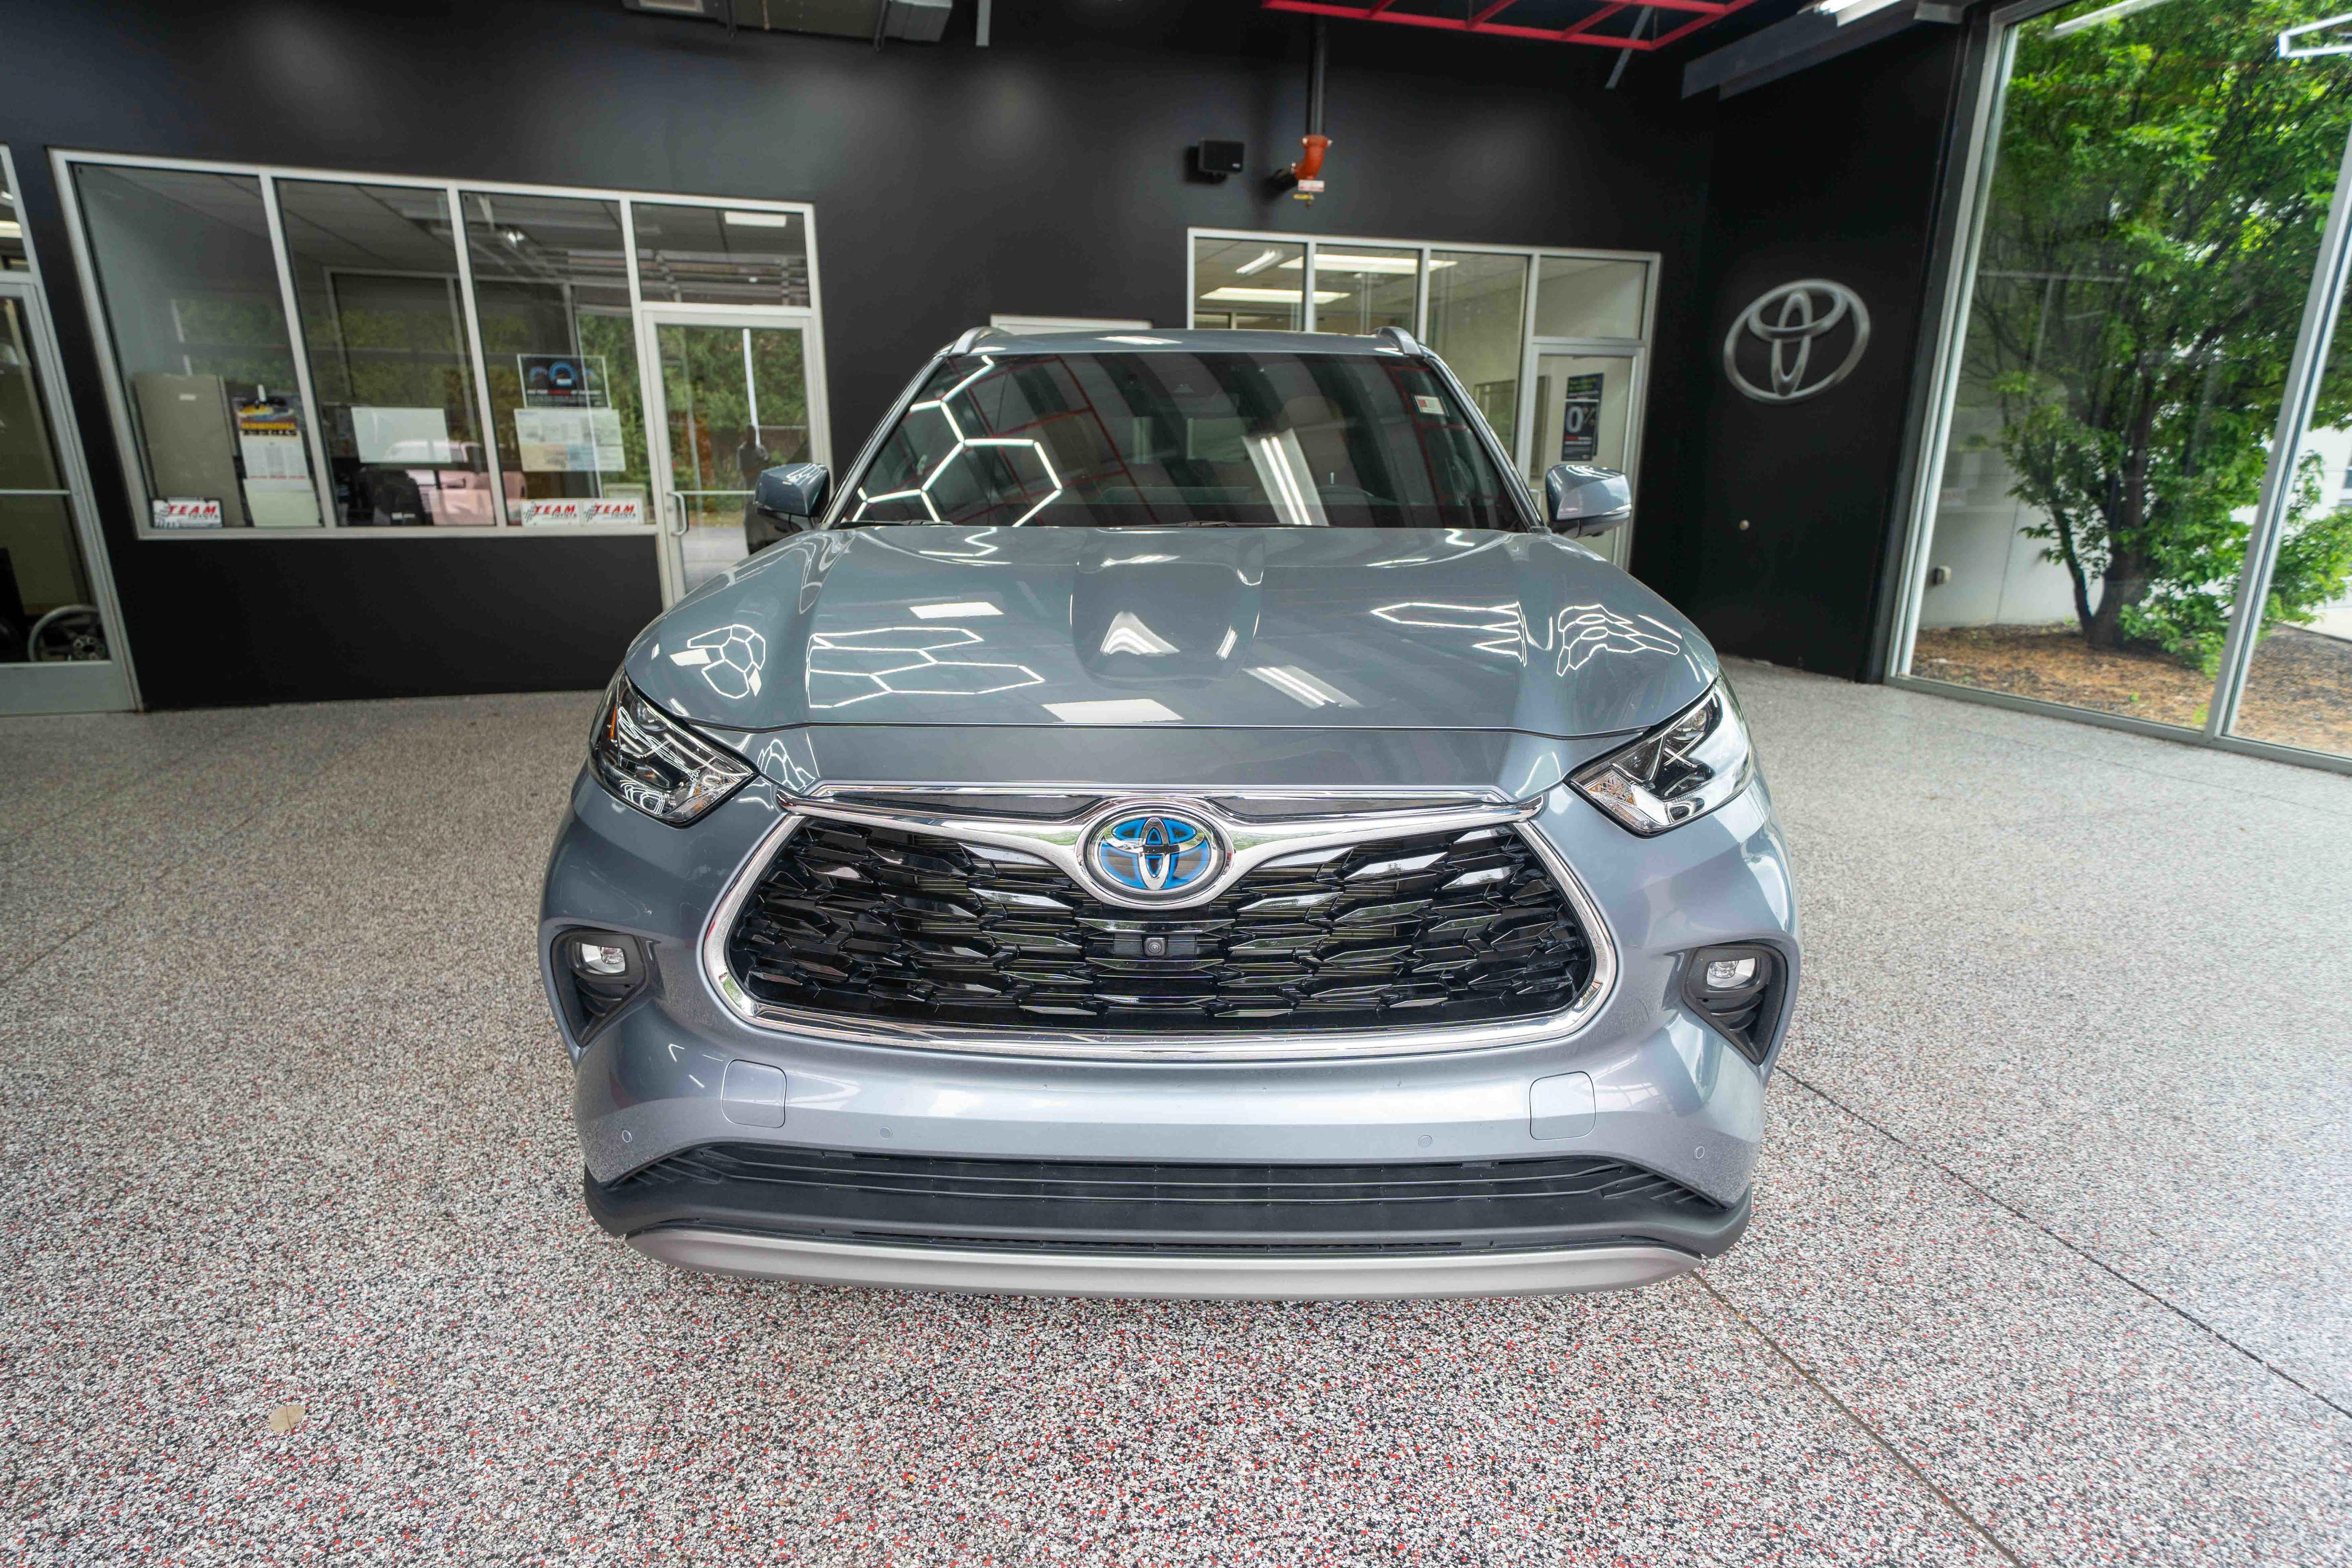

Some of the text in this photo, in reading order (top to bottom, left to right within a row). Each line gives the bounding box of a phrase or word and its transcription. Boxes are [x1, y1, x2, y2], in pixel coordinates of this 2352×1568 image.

[1566, 406, 1595, 433] 0%
[168, 504, 217, 515] TEAM
[535, 505, 576, 514] TEAM
[595, 505, 635, 514] TEAM
